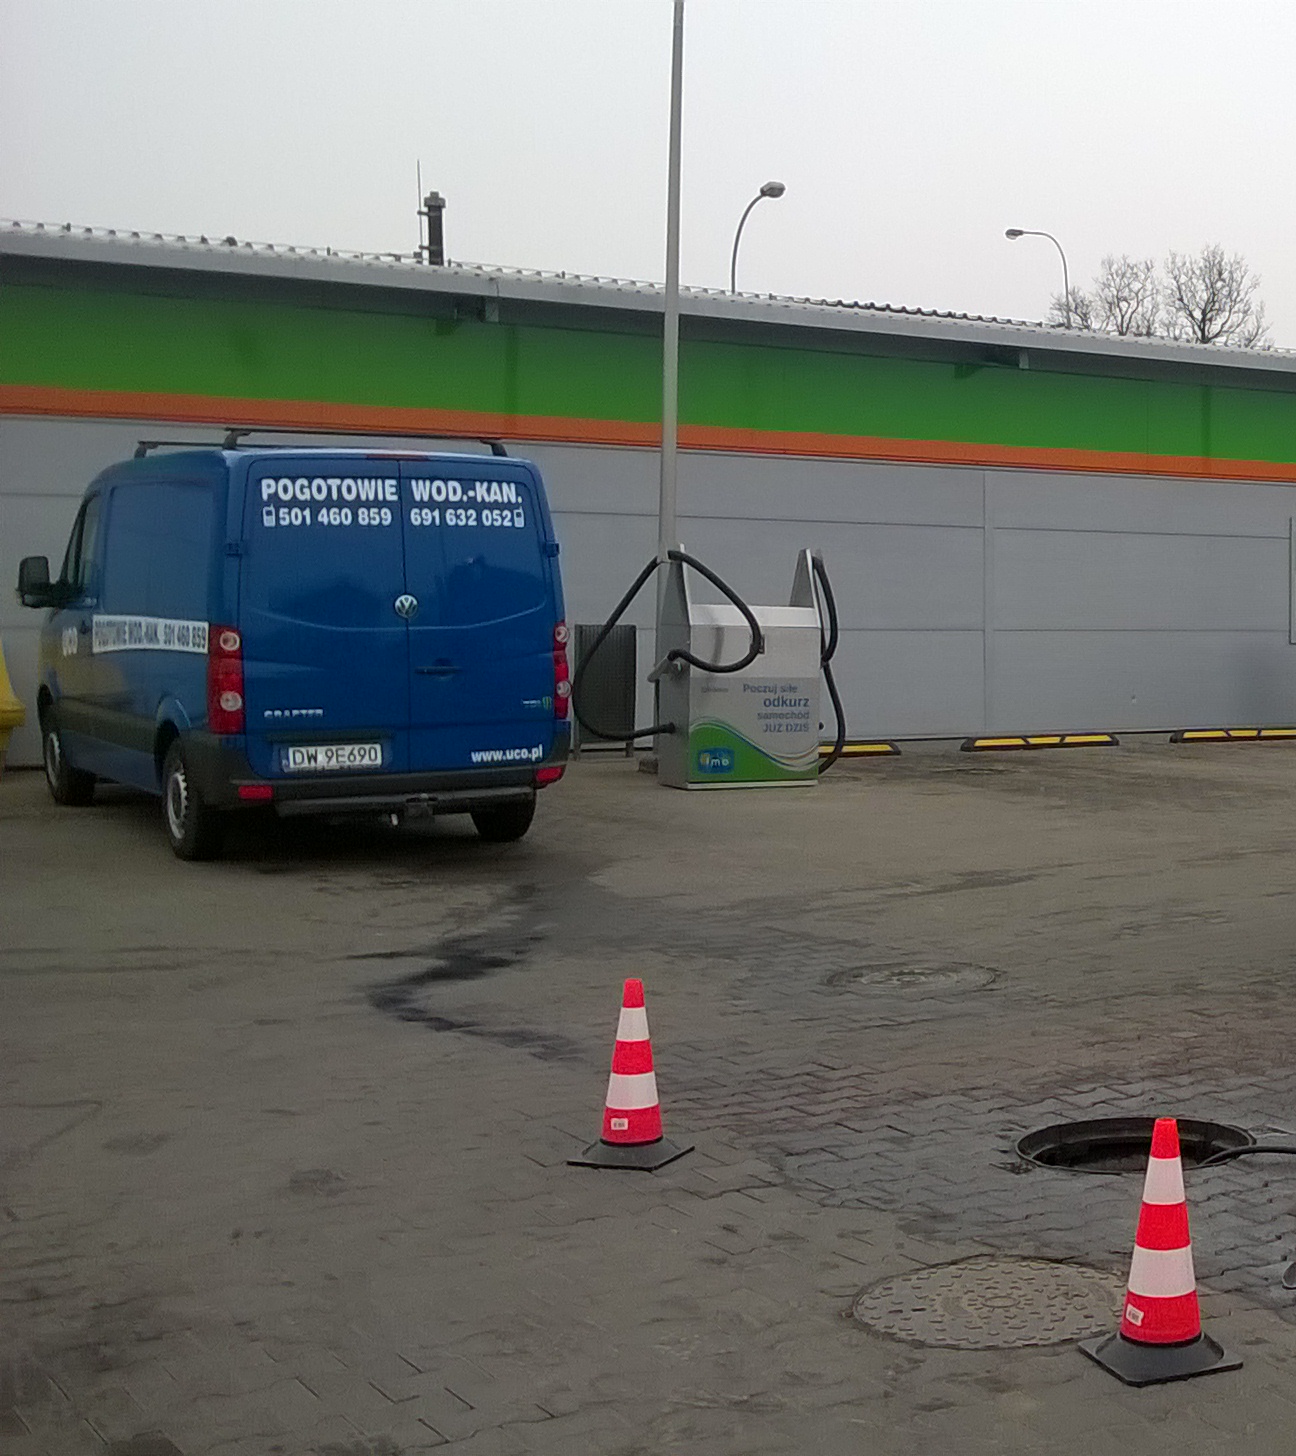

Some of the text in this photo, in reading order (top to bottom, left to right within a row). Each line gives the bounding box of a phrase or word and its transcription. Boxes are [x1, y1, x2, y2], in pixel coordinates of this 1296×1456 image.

[261, 478, 523, 503] POGOTOWIE WOD.-KAN.
[279, 507, 513, 527] 501 460 859 691 632 052
[743, 684, 778, 695] Poczuj
[763, 696, 810, 707] odkurz
[292, 749, 318, 766] DW
[325, 746, 378, 764] 9E690
[471, 744, 543, 762] www.uco.pl
